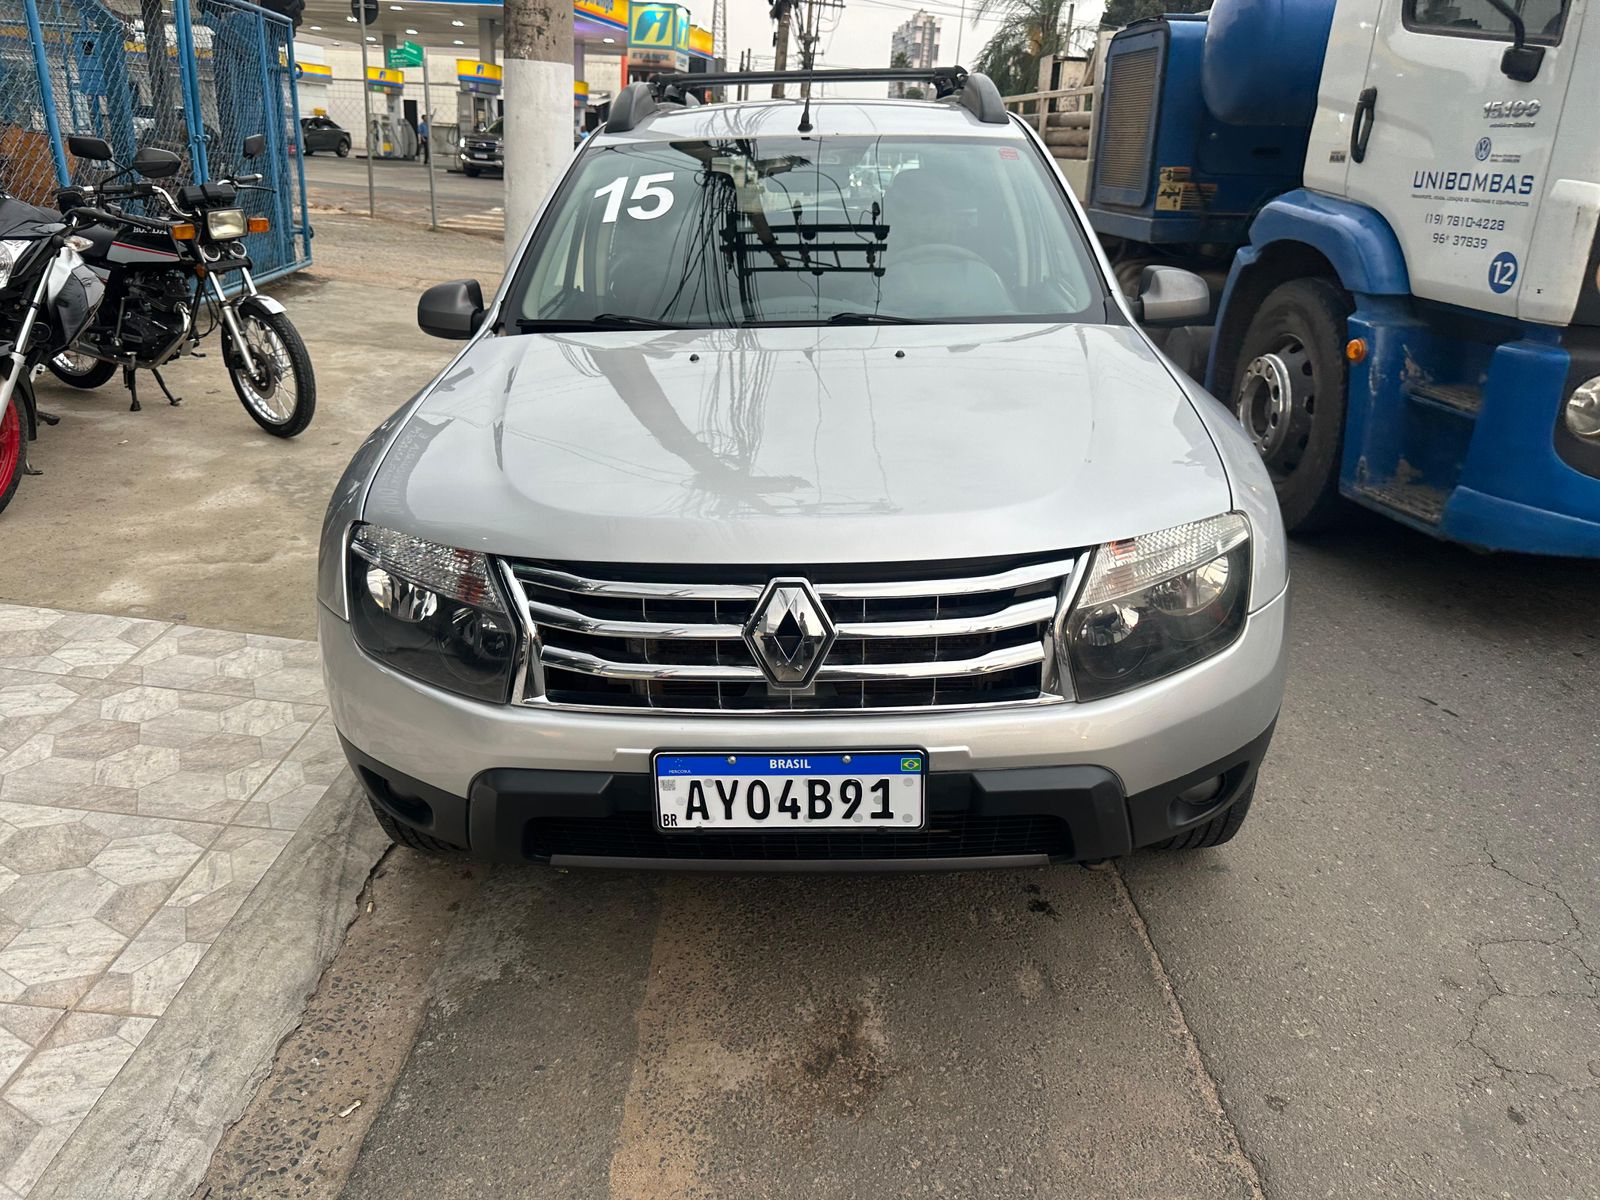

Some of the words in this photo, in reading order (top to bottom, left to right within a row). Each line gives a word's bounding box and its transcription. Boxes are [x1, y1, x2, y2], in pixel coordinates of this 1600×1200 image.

[1413, 171, 1535, 195] UNIBOMBAS
[594, 172, 675, 223] 15
[1425, 213, 1444, 225] (19)
[1446, 215, 1505, 231] 7810-4228
[1452, 235, 1488, 249] 37839
[1493, 261, 1515, 285] 12
[769, 759, 811, 769] BRASIL
[662, 814, 678, 827] BR
